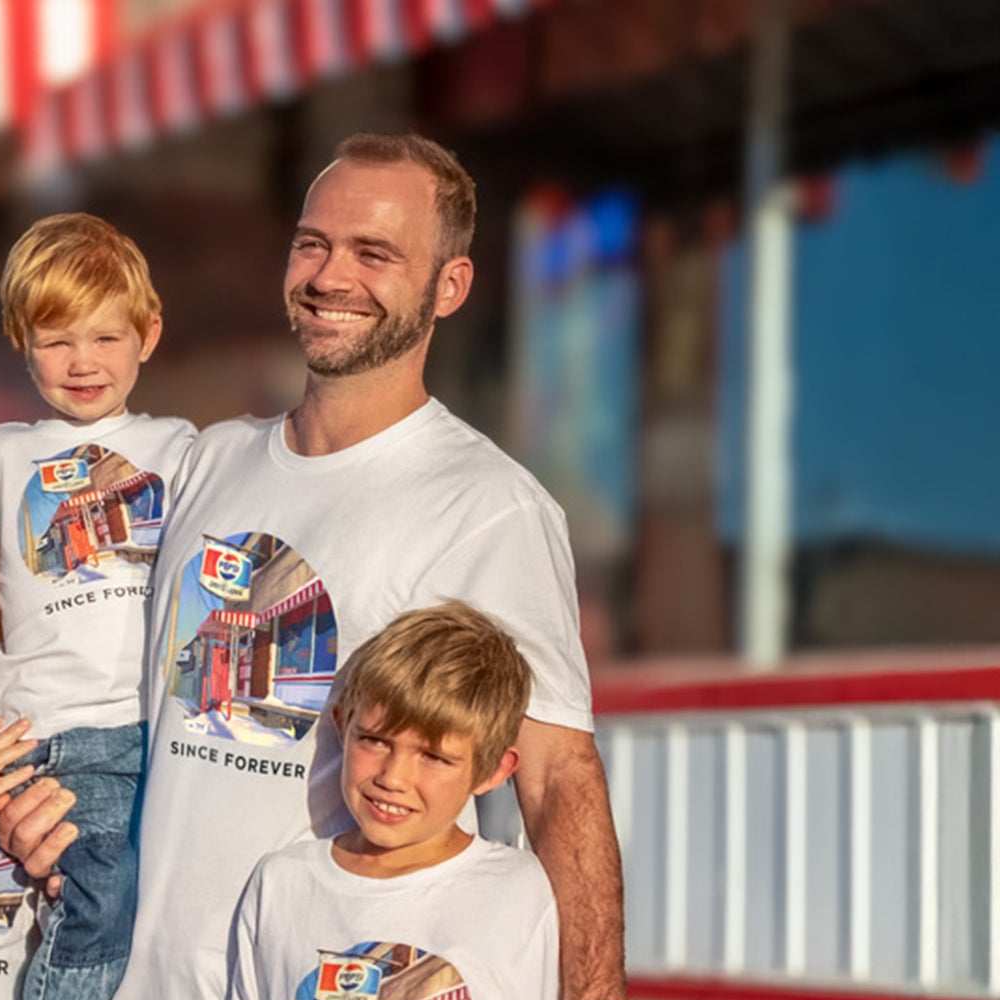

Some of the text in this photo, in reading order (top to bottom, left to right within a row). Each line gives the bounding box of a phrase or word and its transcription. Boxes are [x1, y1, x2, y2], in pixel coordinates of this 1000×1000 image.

[44, 591, 96, 615] SINCE
[170, 741, 306, 779] SINCE FOREVER
